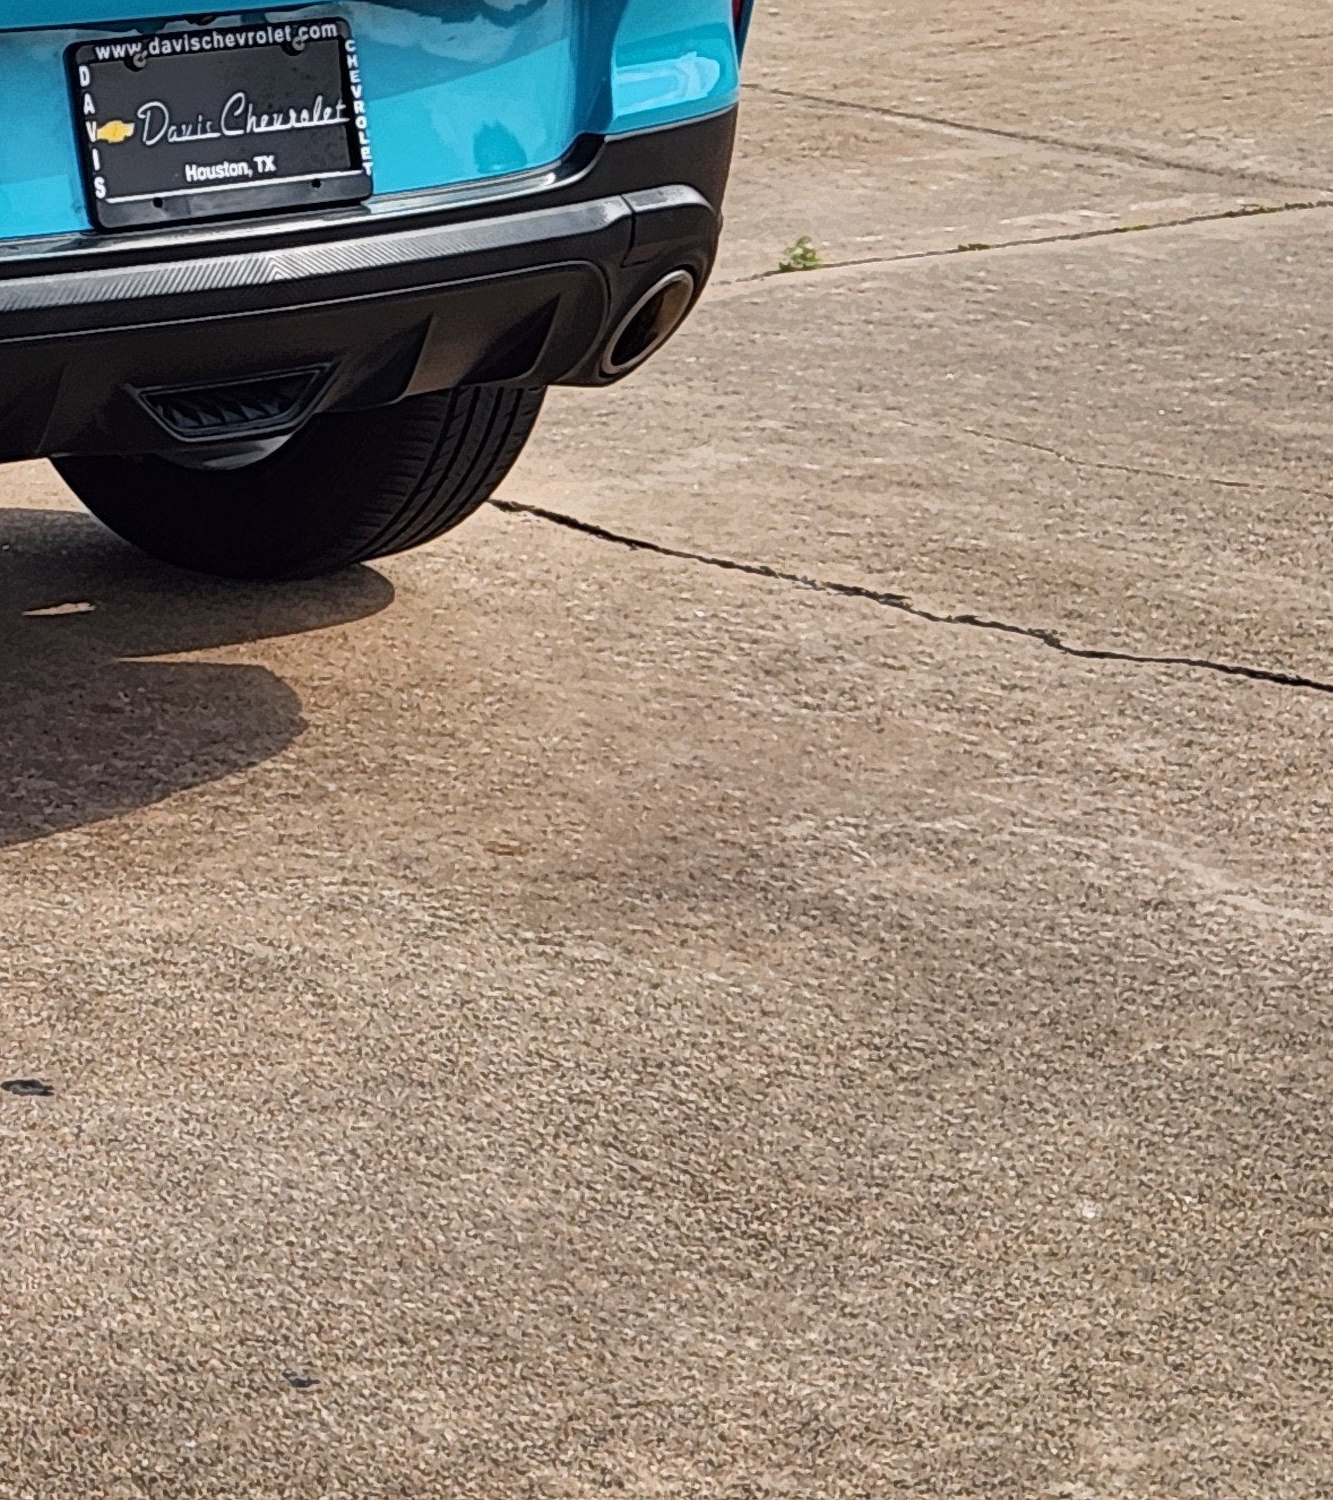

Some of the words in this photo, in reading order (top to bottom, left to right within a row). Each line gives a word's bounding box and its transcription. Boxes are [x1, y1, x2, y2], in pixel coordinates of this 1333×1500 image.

[95, 23, 338, 60] www.davischevrolet.com
[78, 65, 107, 200] DAVIS
[136, 101, 222, 146] Davis
[220, 91, 350, 136] Chevrolet
[344, 39, 373, 177] CHEVROLET
[185, 160, 253, 183] Houston,
[253, 155, 276, 173] TX
